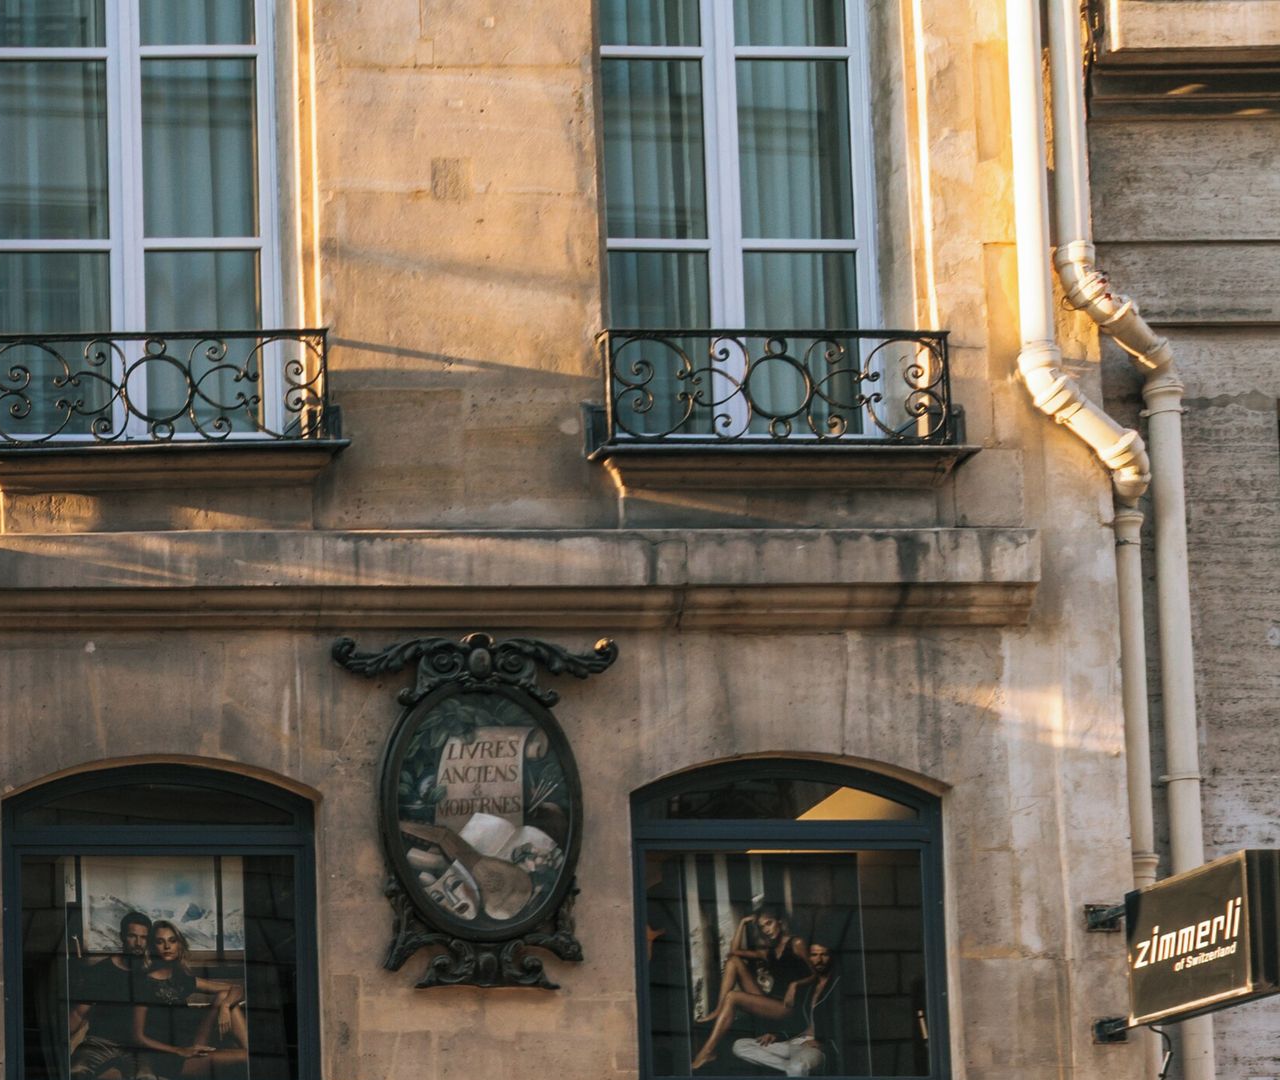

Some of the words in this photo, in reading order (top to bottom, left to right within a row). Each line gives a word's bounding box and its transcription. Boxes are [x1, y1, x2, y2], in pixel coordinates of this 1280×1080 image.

[446, 740, 519, 760] LIVRES
[439, 764, 519, 784] ANCIENS
[437, 796, 521, 816] MODERNES
[1134, 897, 1242, 969] zimmerli
[1174, 958, 1186, 971] of
[1185, 941, 1237, 968] Switzerland
